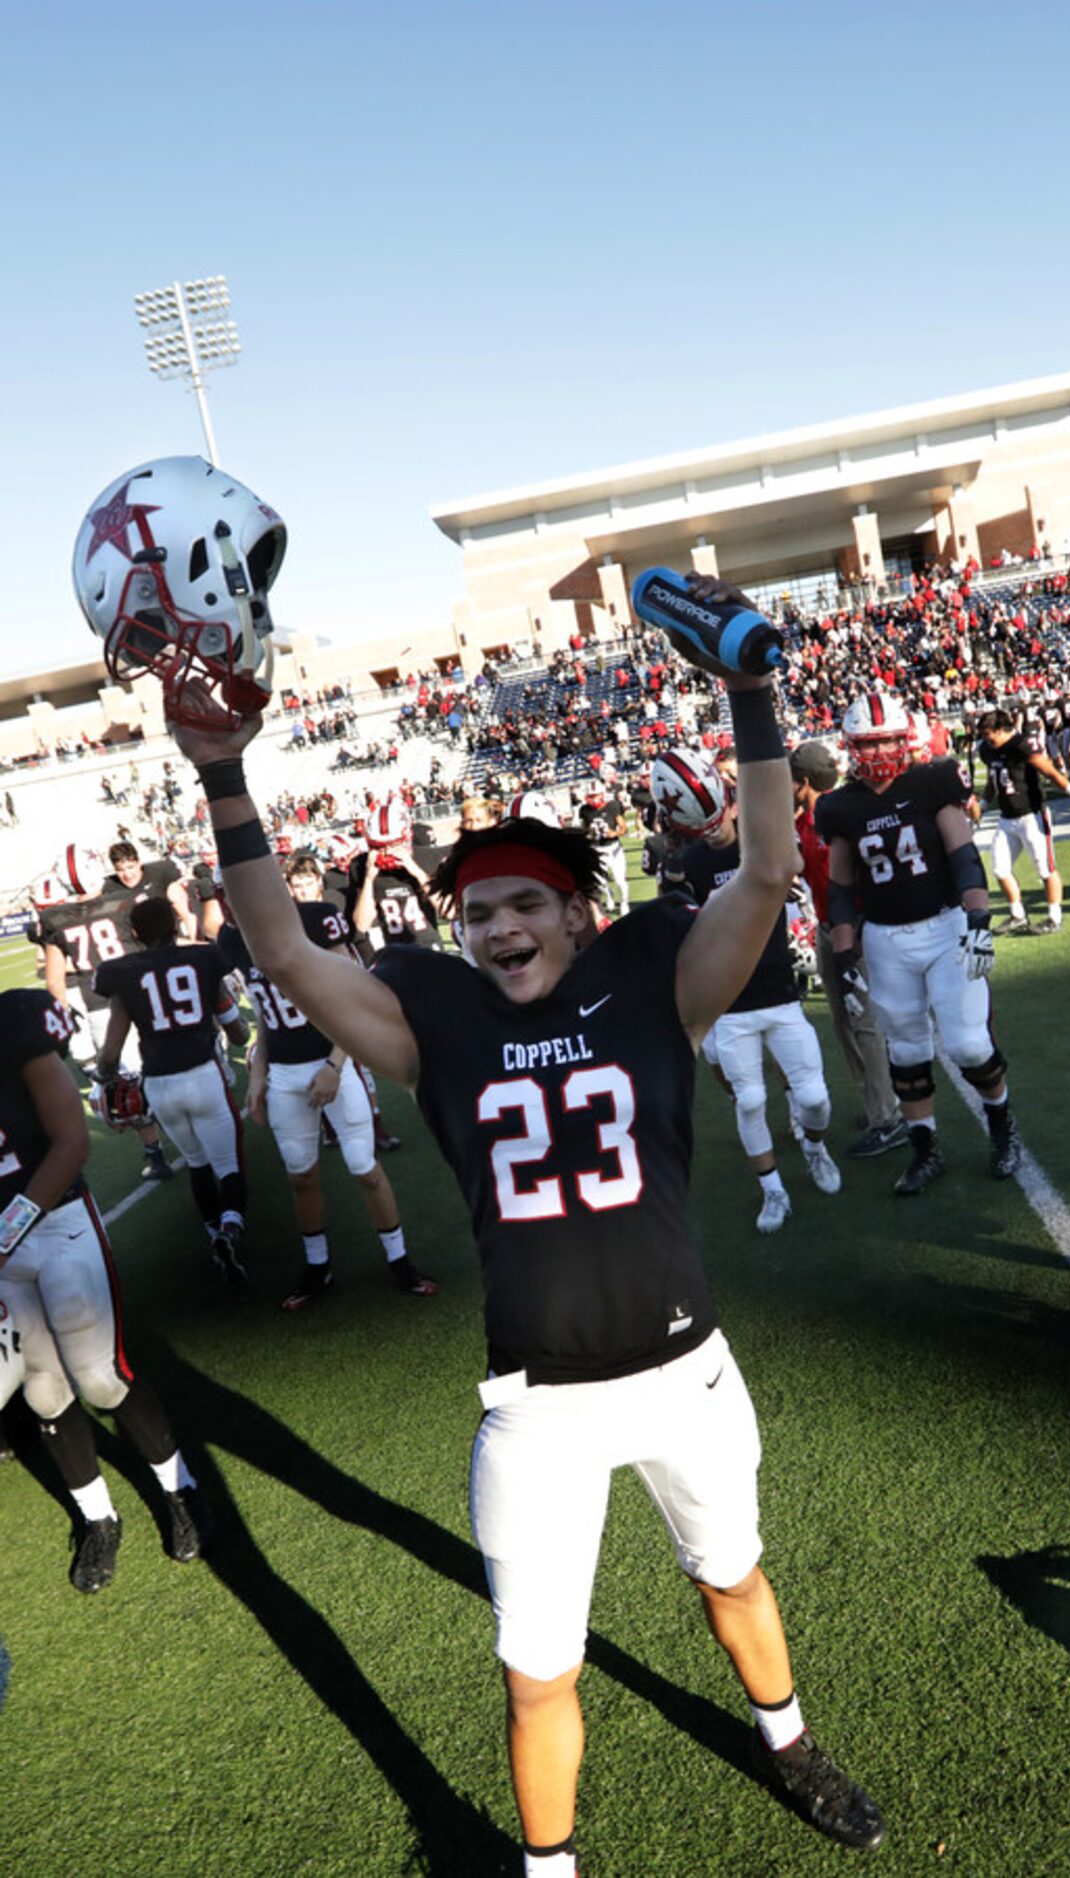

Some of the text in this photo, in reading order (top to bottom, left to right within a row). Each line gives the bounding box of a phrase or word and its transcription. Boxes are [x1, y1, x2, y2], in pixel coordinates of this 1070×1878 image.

[649, 584, 722, 628] POWERADE
[866, 814, 901, 833] COPPELL
[858, 825, 928, 884] 64
[380, 895, 428, 935] 84
[63, 918, 125, 971] 78
[140, 964, 204, 1032] 19
[503, 1033, 593, 1070] COPPELL
[477, 1064, 643, 1222] 23
